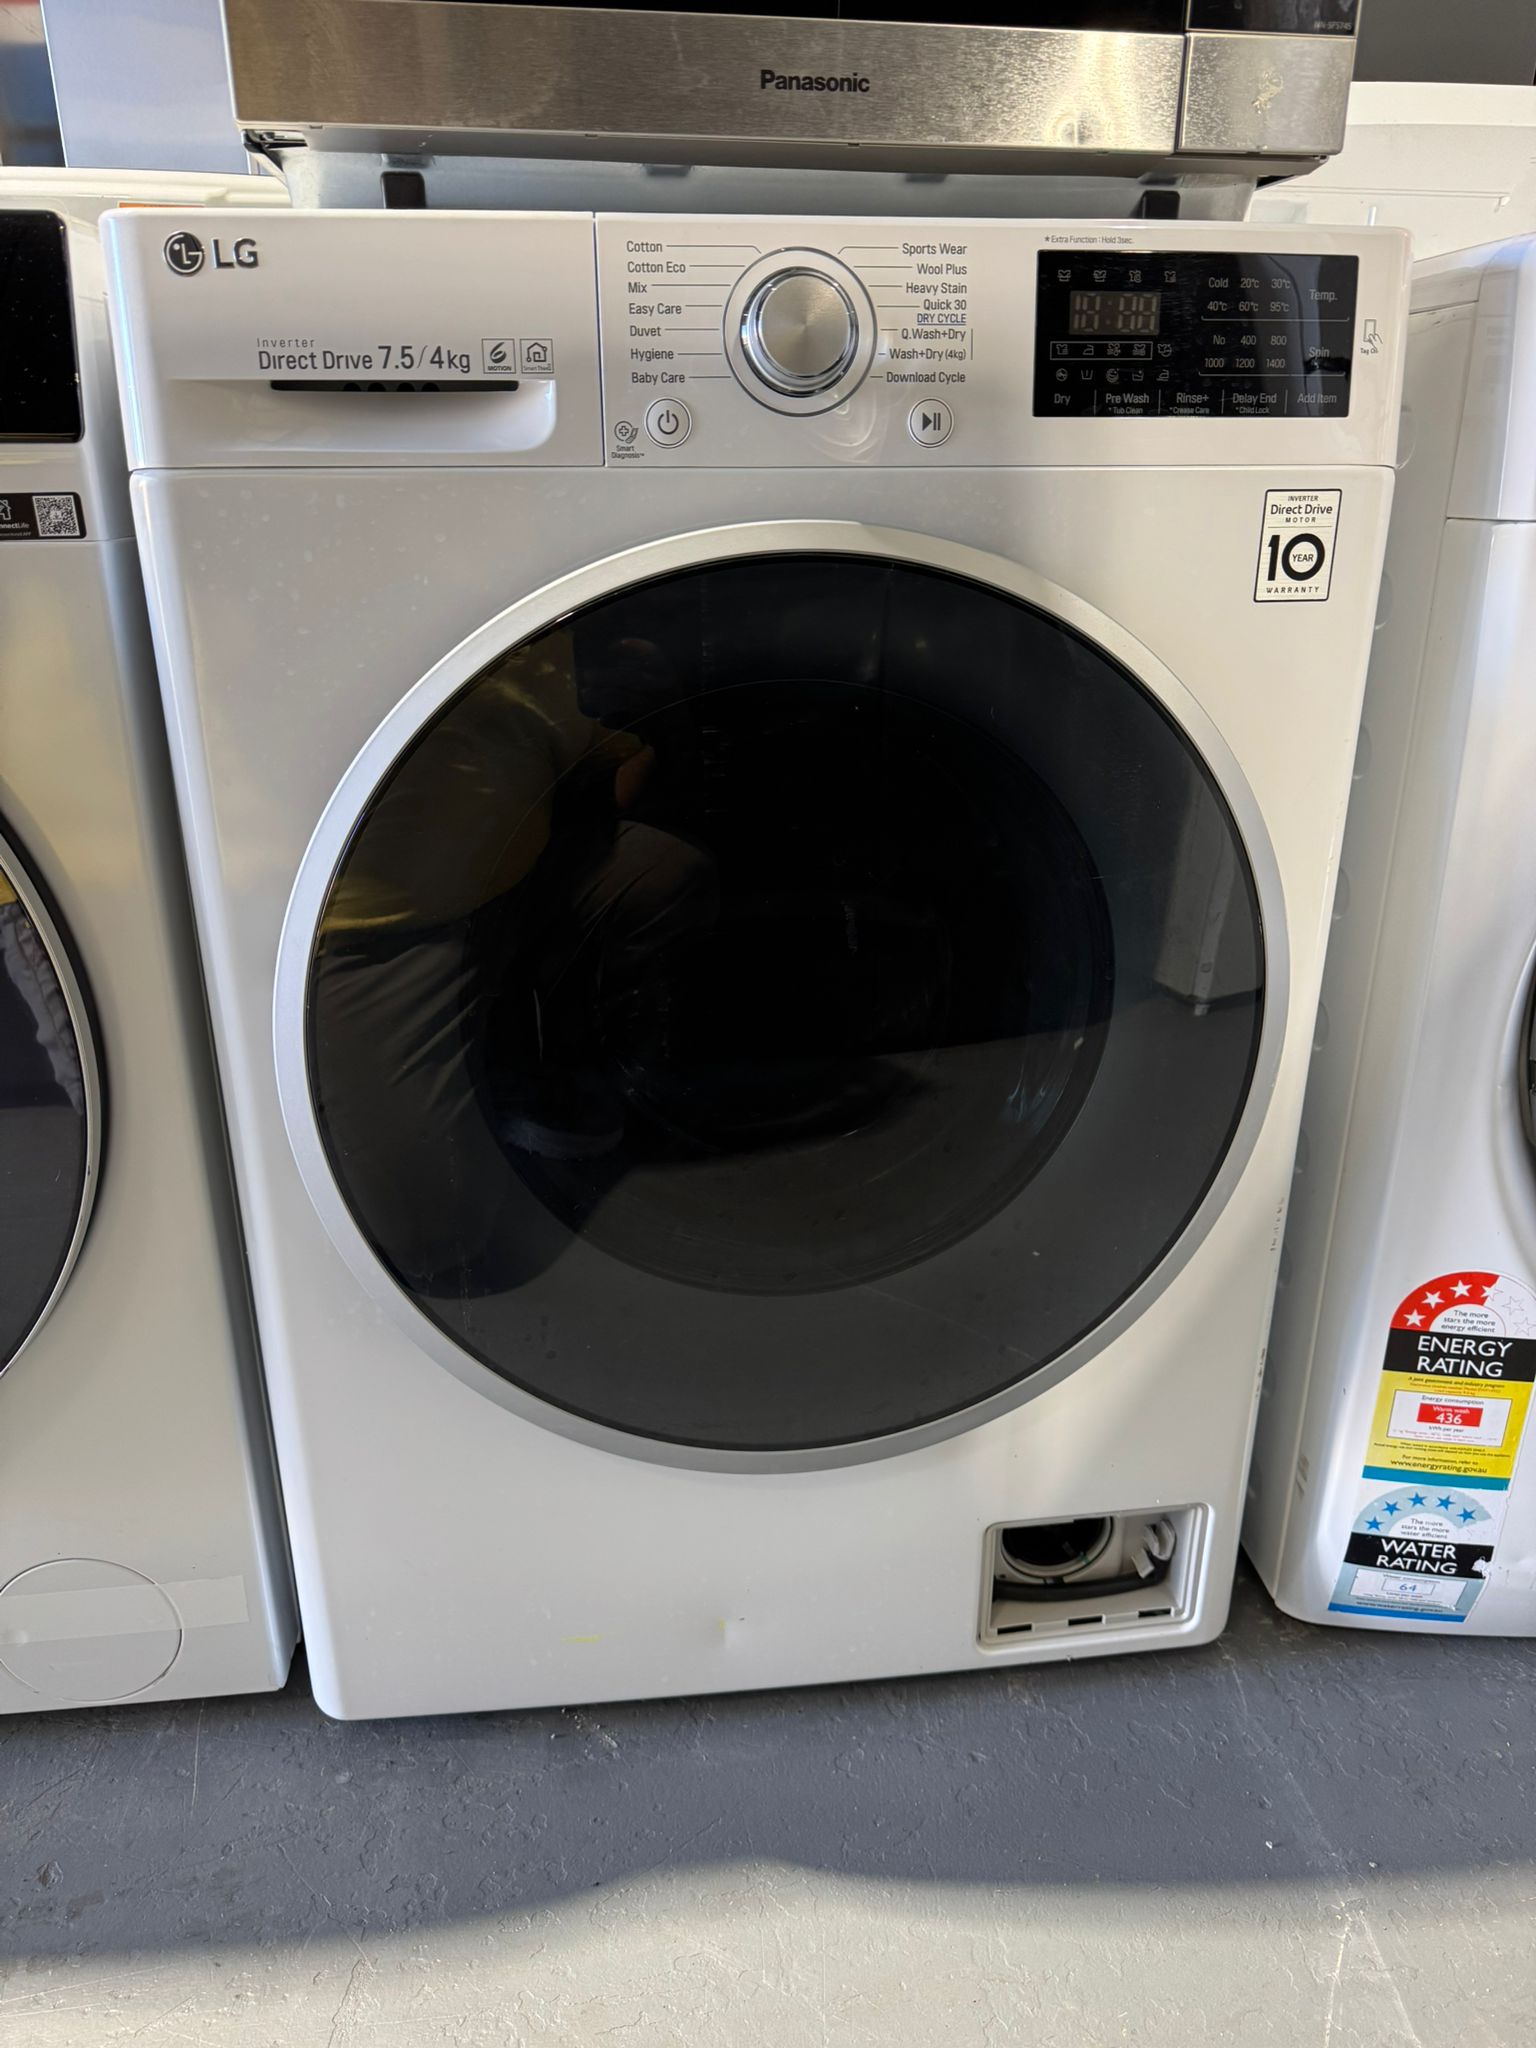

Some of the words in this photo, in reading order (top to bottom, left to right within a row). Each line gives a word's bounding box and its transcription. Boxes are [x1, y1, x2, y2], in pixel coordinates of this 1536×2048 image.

[760, 69, 870, 92] Panasonic
[626, 241, 662, 252] Cotton
[902, 243, 936, 256] Sports
[939, 244, 967, 254] Wear
[213, 238, 259, 269] LG
[628, 262, 663, 272] Cotton
[667, 262, 686, 272] Eco
[917, 264, 943, 274] Wool
[946, 264, 967, 274] Plus
[628, 282, 647, 293] Mix
[1209, 277, 1228, 288] Cold
[906, 283, 938, 295] Heavy
[941, 283, 967, 293] Stain
[1309, 290, 1338, 302] Temp.
[629, 303, 654, 316] Easy
[657, 303, 681, 314] Care
[923, 300, 952, 311] Quick
[955, 300, 966, 310] 30
[917, 314, 935, 323] DRY
[938, 314, 966, 323] CYCLE
[630, 326, 661, 336] Duvet
[902, 329, 966, 341] Q.Wash+Dry
[257, 338, 315, 348] Inverter
[1213, 335, 1225, 345] No
[1241, 335, 1256, 345] 400
[1271, 336, 1287, 345] 800
[631, 349, 674, 361] Hygiene
[890, 349, 943, 361] Wash+Dry
[945, 349, 966, 360] (4kg)
[1309, 347, 1329, 358] Spin
[259, 351, 317, 369] Direct
[323, 351, 373, 369] Drive
[1205, 358, 1224, 367] 1000
[1236, 359, 1255, 368] 1200
[1266, 359, 1285, 368] 1400
[632, 373, 658, 385] Baby
[661, 373, 685, 383] Care
[887, 372, 936, 382] Download
[939, 372, 965, 384] Cycle
[1054, 393, 1070, 405] Dry
[1106, 393, 1121, 403] Pre
[1123, 394, 1149, 403] Wash
[1177, 393, 1209, 403] Rinse+
[1233, 394, 1257, 405] Delay
[1260, 394, 1276, 403] End
[1297, 394, 1315, 403] Add
[1317, 394, 1337, 403] Item
[1271, 504, 1302, 514] Direct
[1305, 504, 1332, 514] Drive
[1268, 533, 1325, 581] 10
[1293, 554, 1314, 562] YEAR
[1467, 1325, 1495, 1333] efficient
[1417, 1336, 1512, 1358] ENERGY
[1417, 1356, 1503, 1377] RATING
[1422, 1395, 1442, 1403] Energy
[1444, 1397, 1484, 1405] consumption
[1436, 1413, 1462, 1424] 436
[1381, 1539, 1456, 1559] WATER
[1377, 1555, 1458, 1574] RATING
[1400, 1583, 1416, 1592] 64
